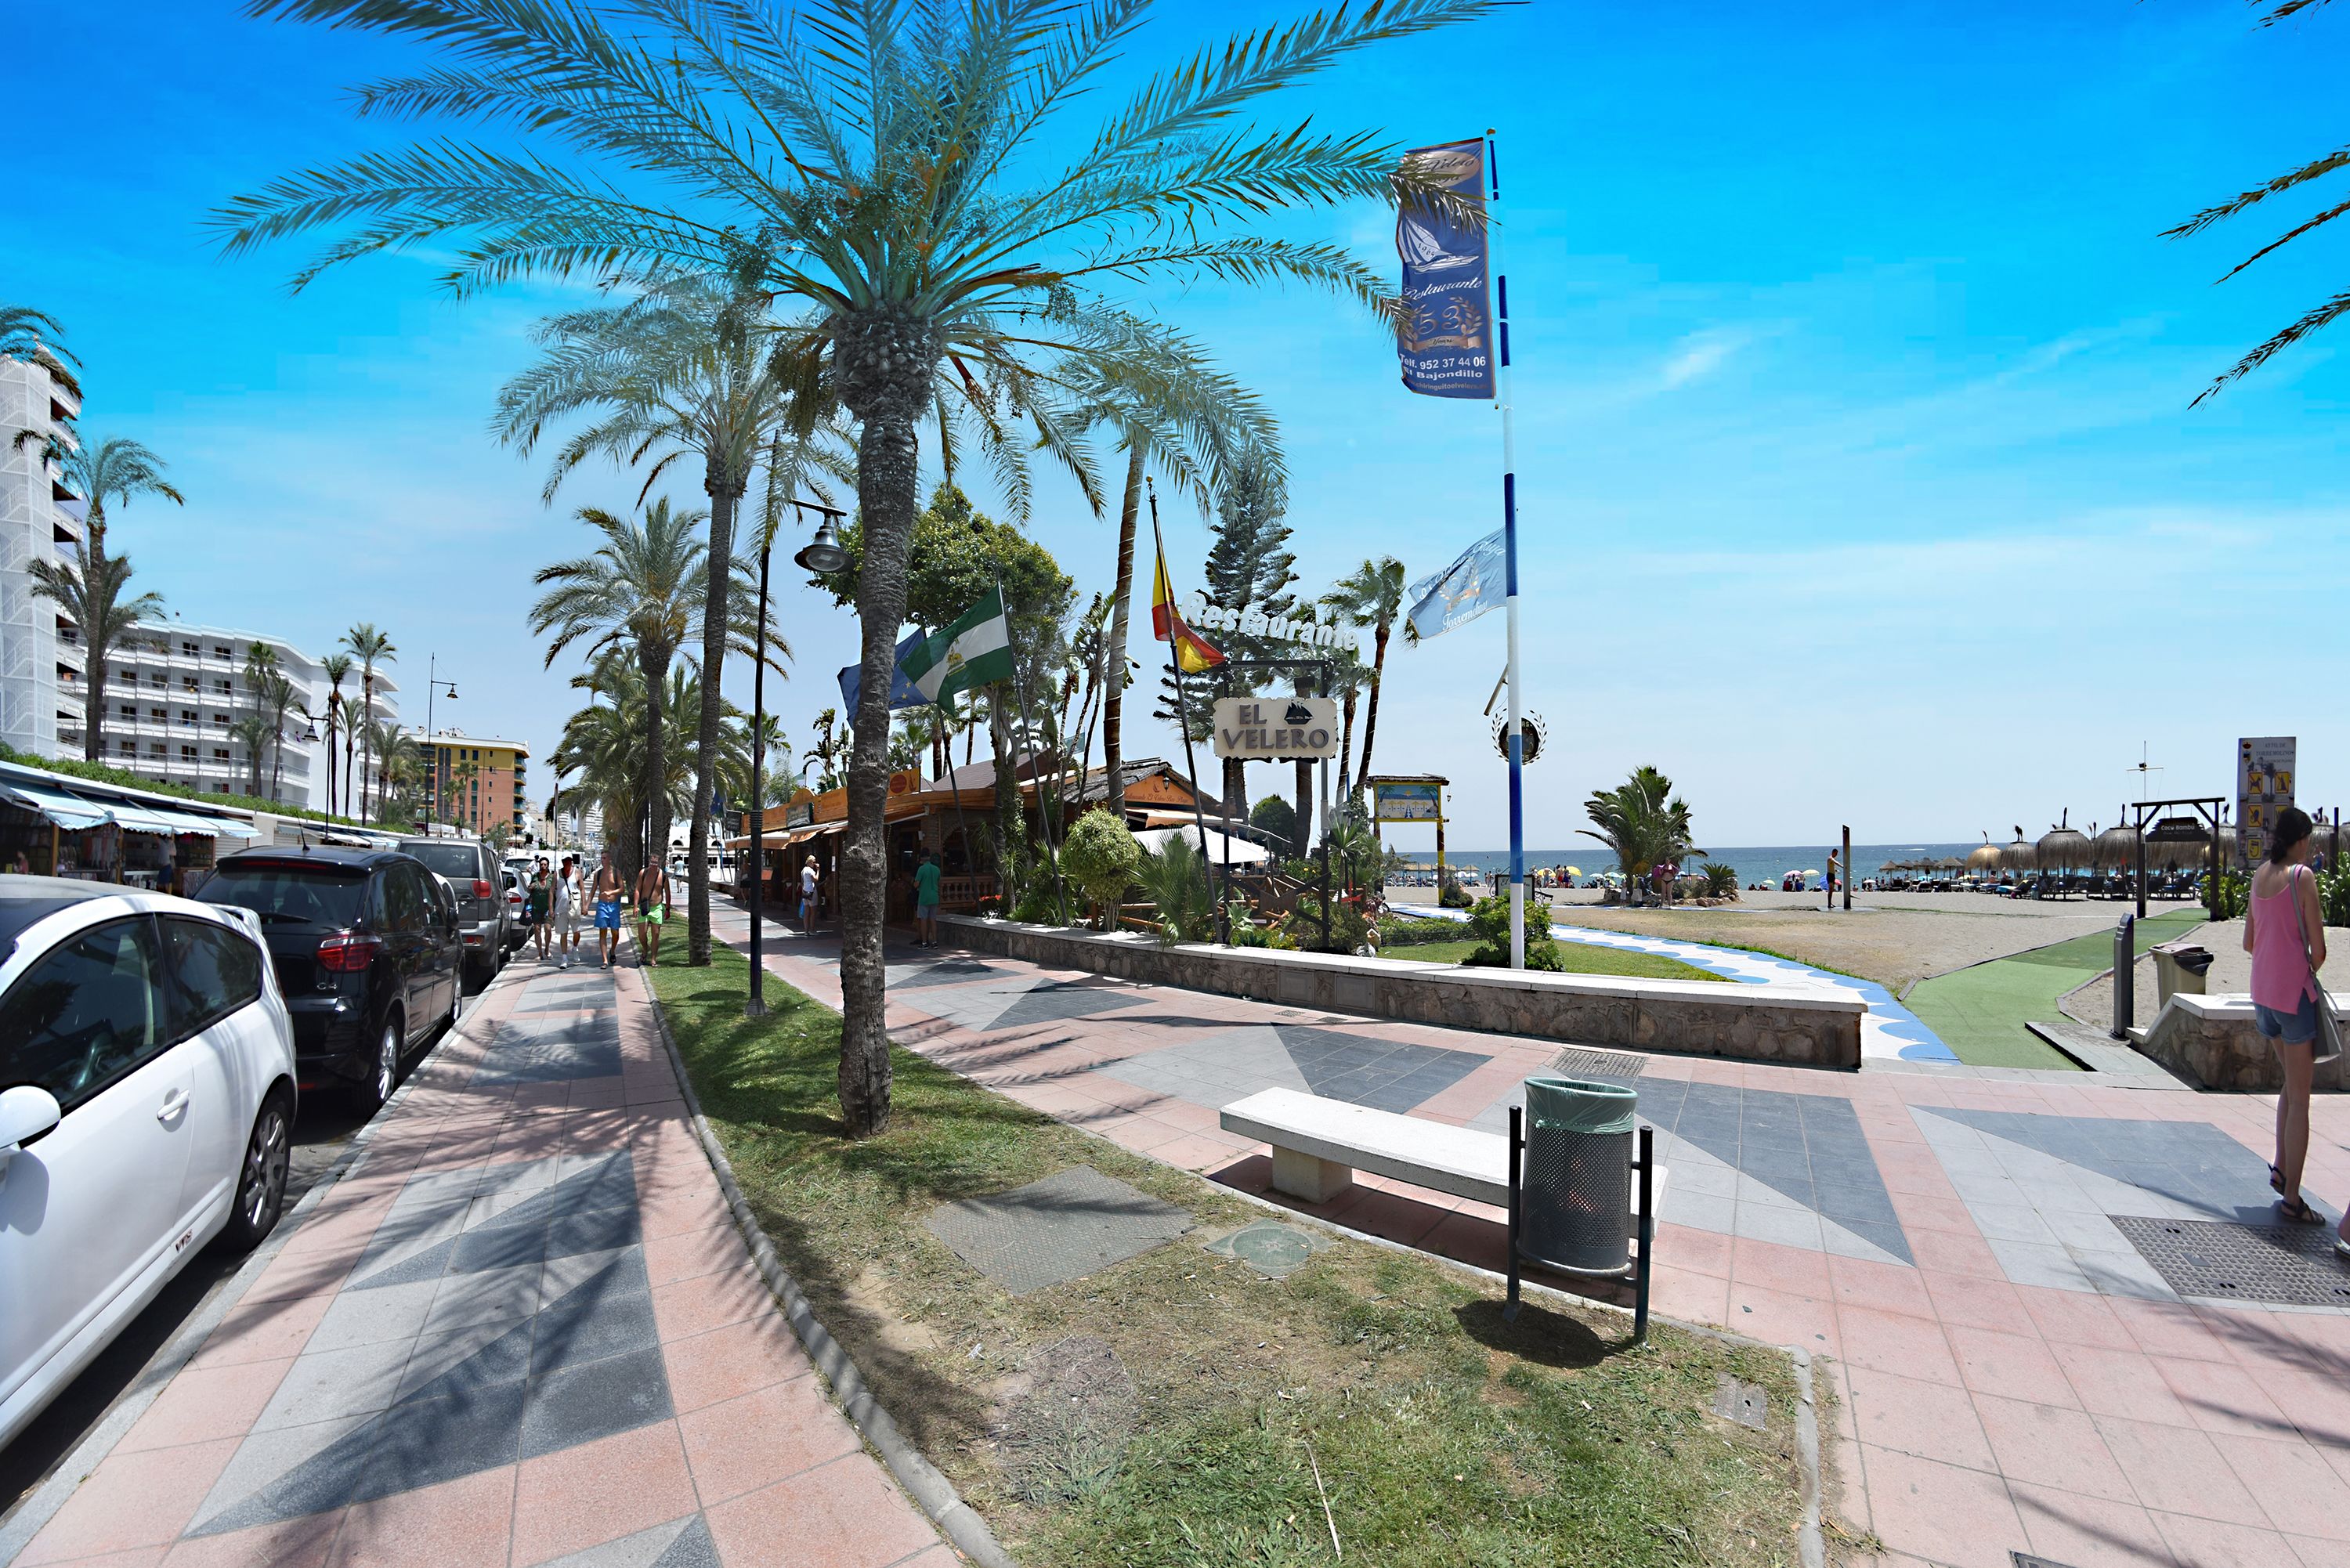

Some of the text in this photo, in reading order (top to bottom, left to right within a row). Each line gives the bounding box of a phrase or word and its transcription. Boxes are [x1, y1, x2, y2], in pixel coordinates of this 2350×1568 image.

[1403, 277, 1482, 300] Restaurante
[1400, 353, 1486, 370] Telf. 952 37 44 06
[1416, 369, 1483, 381] Bajondillo
[1180, 592, 1360, 651] Restaurante
[1239, 705, 1267, 725] EL
[1222, 728, 1329, 750] VELERO
